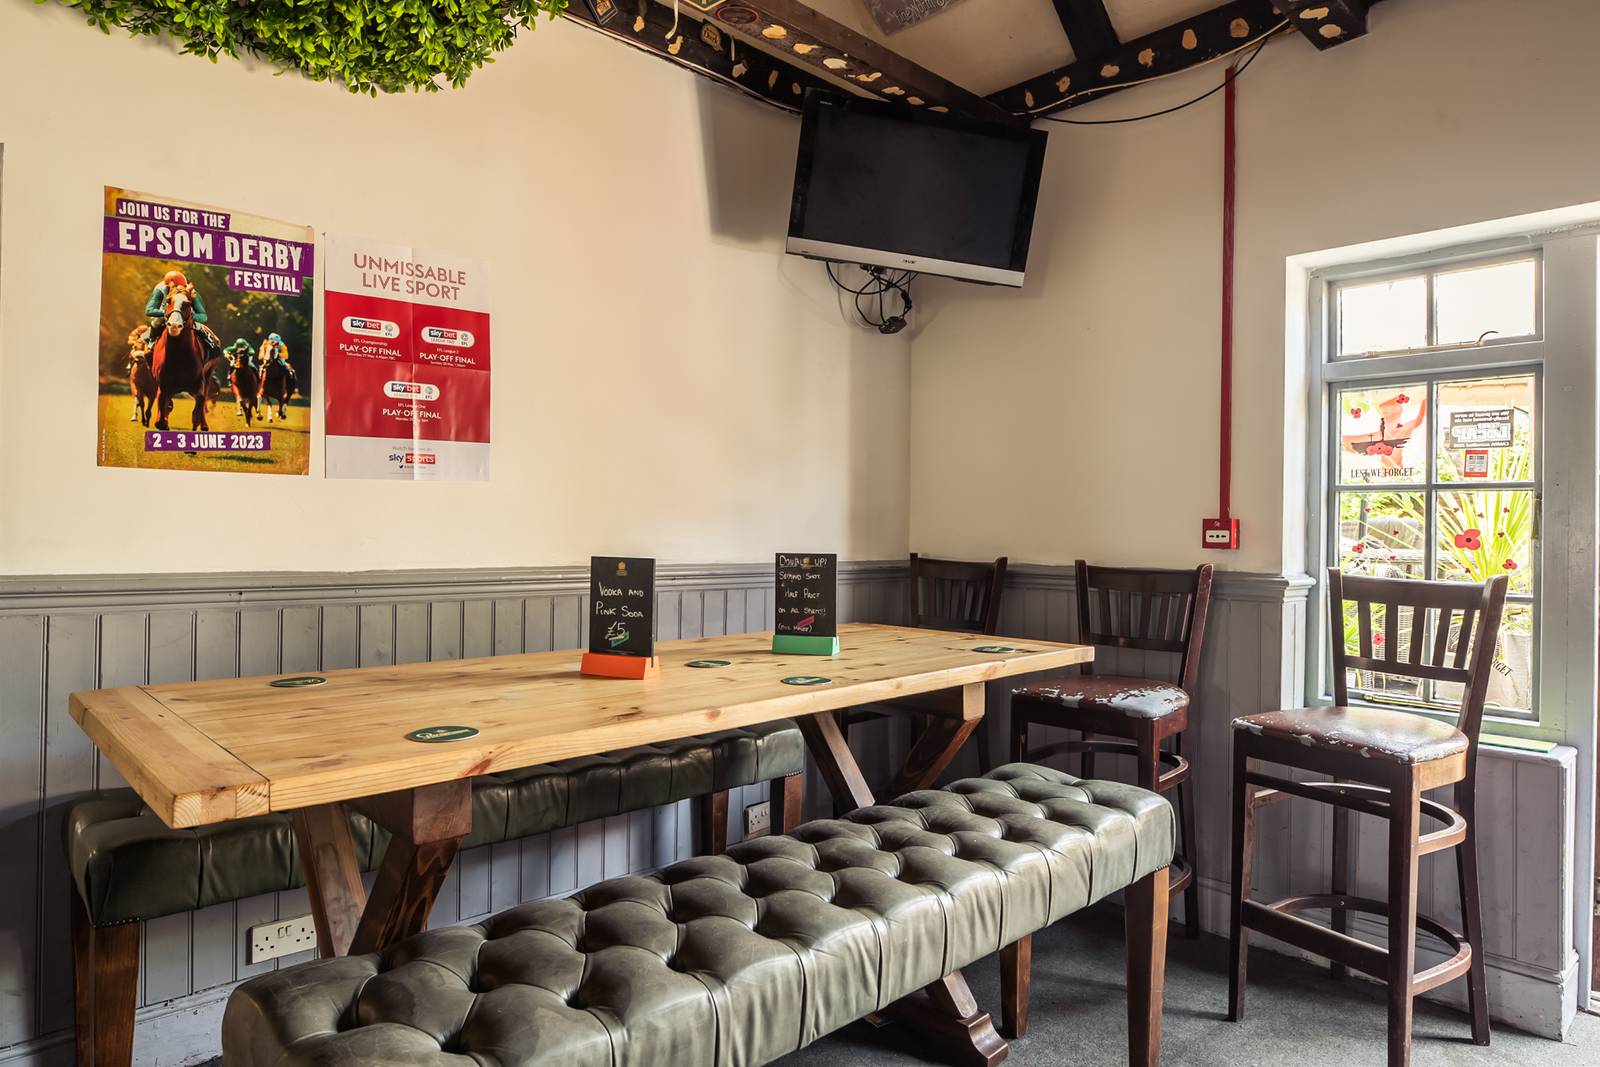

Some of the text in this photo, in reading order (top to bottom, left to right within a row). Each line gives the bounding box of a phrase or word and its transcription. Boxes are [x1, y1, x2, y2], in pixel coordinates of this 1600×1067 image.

[118, 201, 226, 228] JOIN US FOR THE
[118, 221, 303, 271] EPSOM DERBY
[354, 253, 466, 286] UNMISSABLE
[234, 270, 300, 294] FESTIVAL
[362, 272, 460, 301] LIVE SPORT
[352, 319, 380, 330] sky bet
[430, 329, 456, 339] sky bet
[339, 343, 402, 357] PLAY-OFF FINAL
[419, 352, 476, 365] PLAY-OFF FINAL
[392, 384, 420, 394] sky bet
[420, 410, 442, 420] FINAL
[152, 433, 162, 448] 2
[177, 434, 186, 449] 3
[191, 434, 226, 449] JUNE
[230, 435, 264, 450] 2023
[388, 453, 404, 463] sky
[1350, 467, 1414, 479] LEST WE FORGET
[599, 581, 644, 597] VODKA AND
[595, 601, 644, 618] PINK SODA
[605, 621, 626, 640] £5
[1491, 658, 1514, 677] RGET
